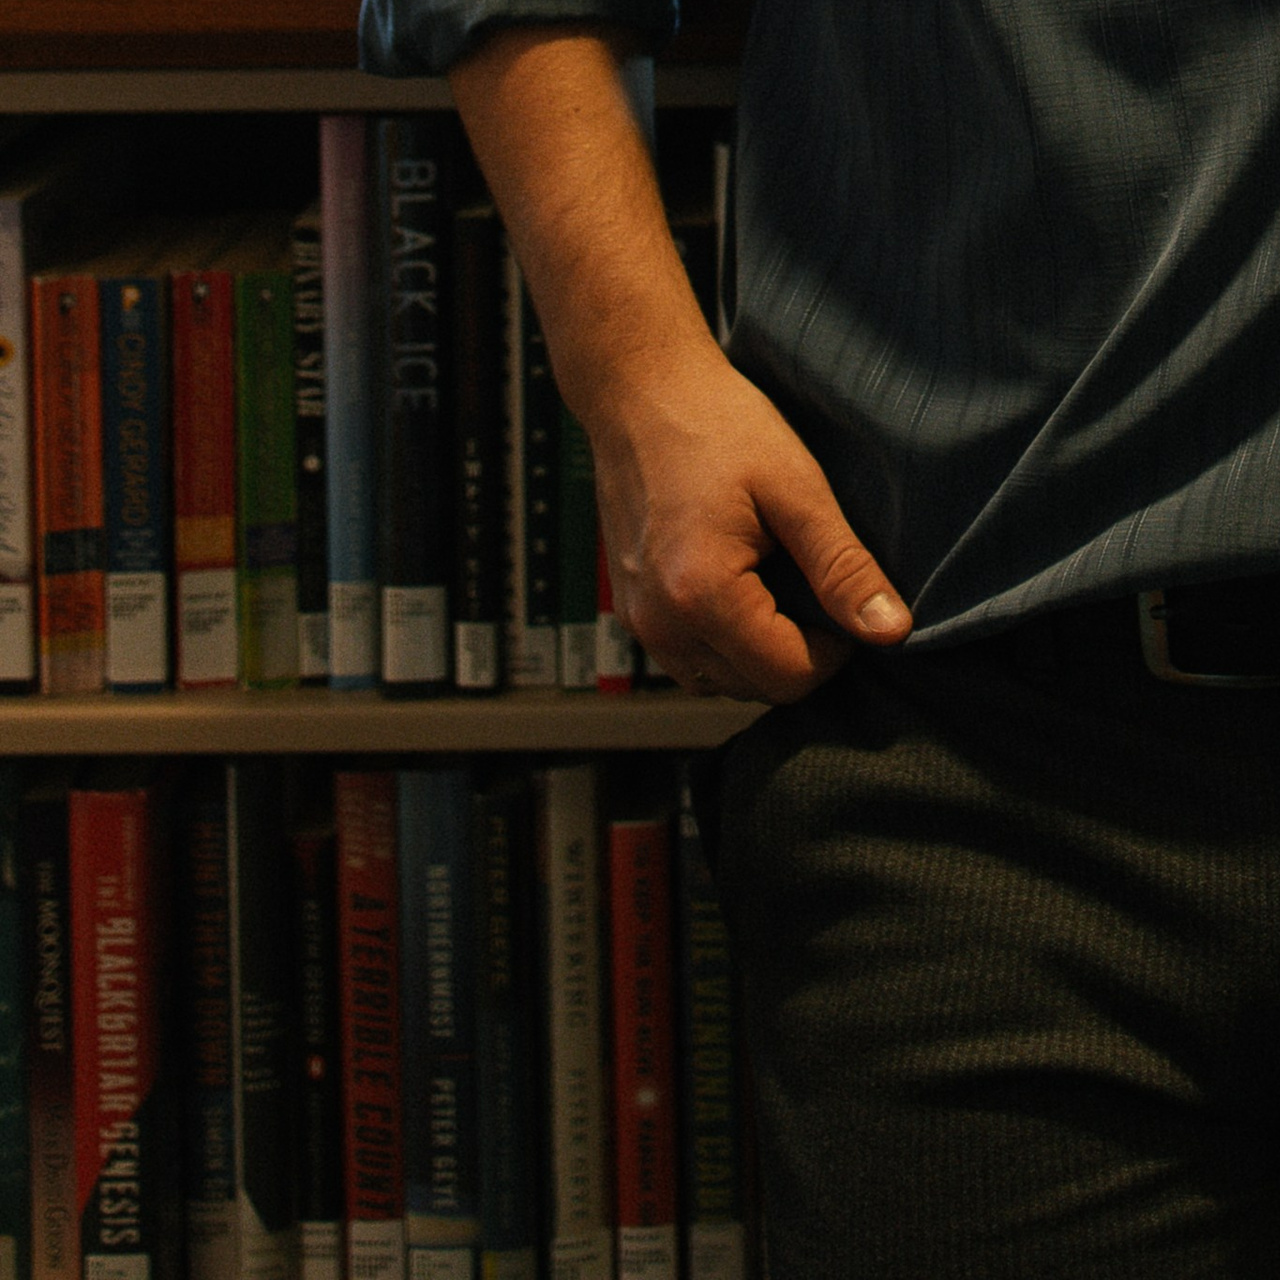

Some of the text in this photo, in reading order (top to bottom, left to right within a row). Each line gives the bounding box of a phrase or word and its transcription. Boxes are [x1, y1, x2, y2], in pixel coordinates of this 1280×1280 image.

[390, 159, 439, 412] BLACK ICE
[116, 332, 148, 413] CINDY
[118, 417, 149, 527] GERARD
[195, 911, 228, 989] THEM
[353, 894, 391, 920] A
[426, 864, 454, 1040] NORTHERNMOST
[567, 839, 592, 1030] WINTERING
[36, 898, 66, 1054] MOONQUEST
[352, 924, 394, 1090] TERRIBLE
[100, 1120, 141, 1246] GENESIS
[353, 1104, 396, 1221] COUNT
[431, 1077, 458, 1210] PETER GEYE
